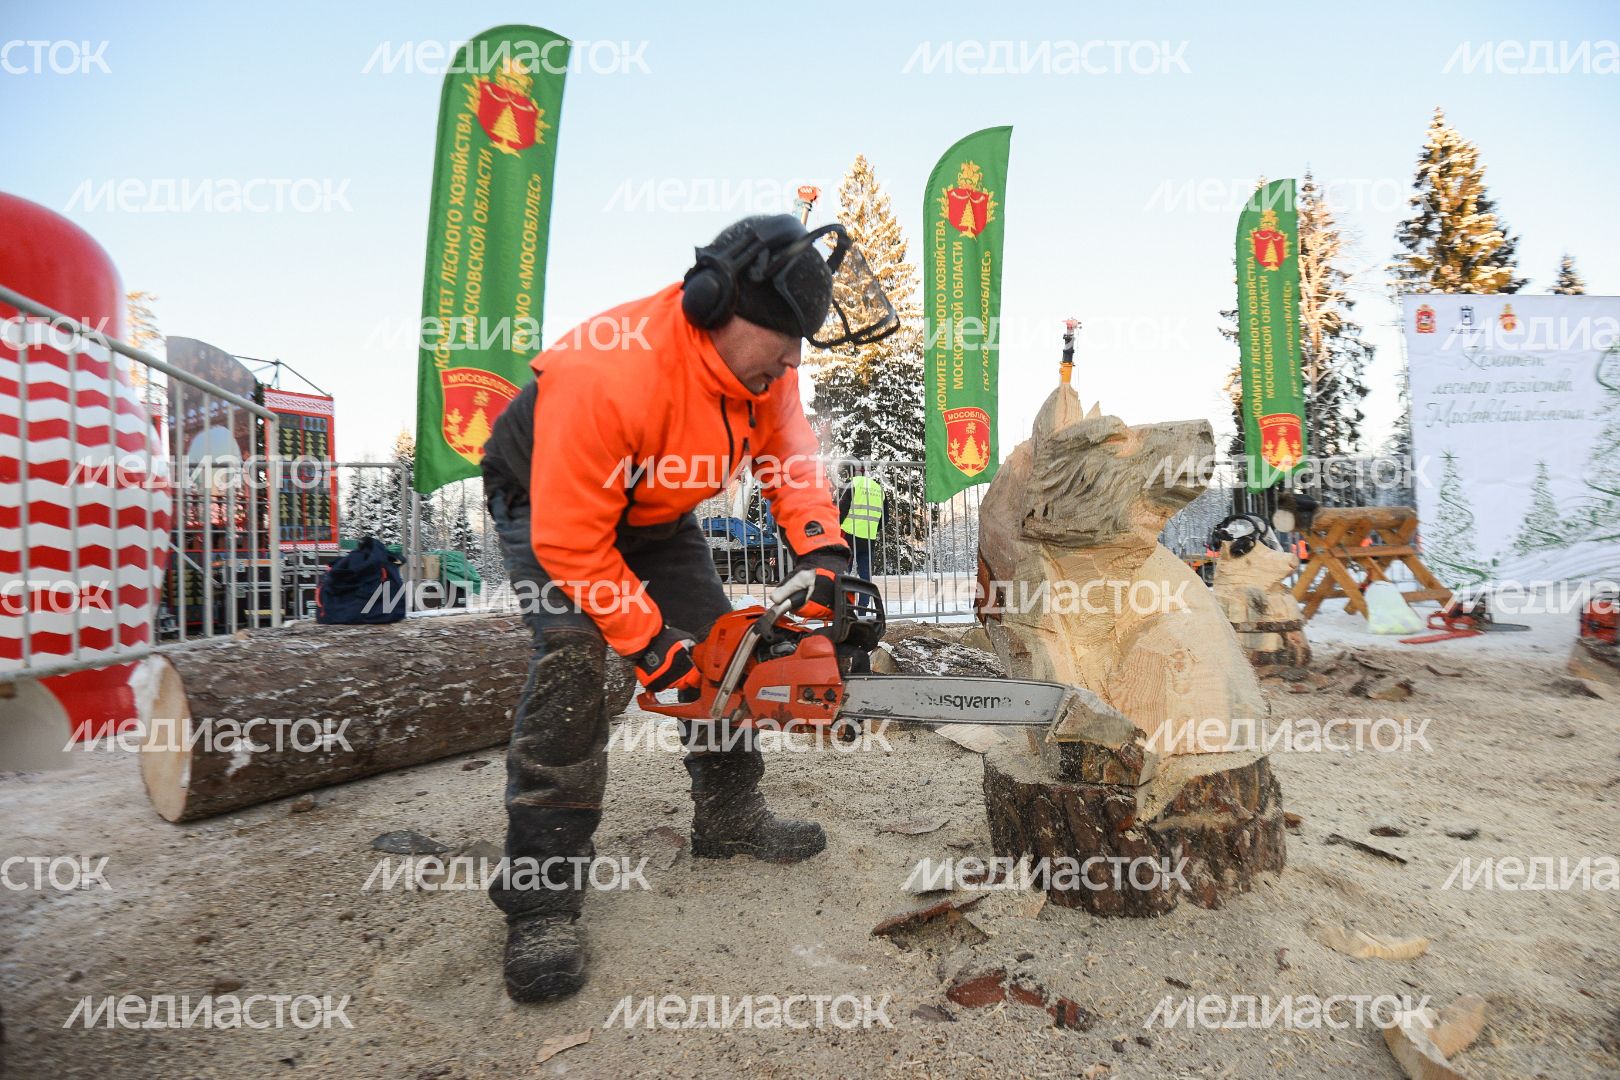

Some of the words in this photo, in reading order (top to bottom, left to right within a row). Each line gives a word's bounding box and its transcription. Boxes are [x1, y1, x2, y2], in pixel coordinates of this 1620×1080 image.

[449, 113, 473, 207] ХОЗЯЙСТВА
[472, 148, 493, 223] ОБЛАСТИ
[440, 209, 463, 286] ЛЕСНОГО
[519, 174, 542, 290] «МОСОБЛЛЕС»
[934, 220, 947, 290] ХОЗЯЙСТВА
[459, 226, 486, 344] МОСКОВСКОЙ
[953, 241, 964, 298] ОБЛАСТИ
[1245, 256, 1259, 315] ХОЗЯЙСТВА
[1259, 275, 1272, 323] ОБЛАСТИ
[433, 287, 454, 369] КОМИТЕТ
[936, 293, 947, 350] ЛЕСНОГО
[951, 301, 964, 390] МОСКОВСКОЙ
[1250, 318, 1262, 365] ЛЕСНОГО
[936, 352, 947, 411] КОМИТЕТ
[1252, 366, 1263, 418] КОМИТЕТ
[1262, 326, 1275, 399] МОСКОВСКОЙ
[922, 692, 1012, 711] usqvarn
